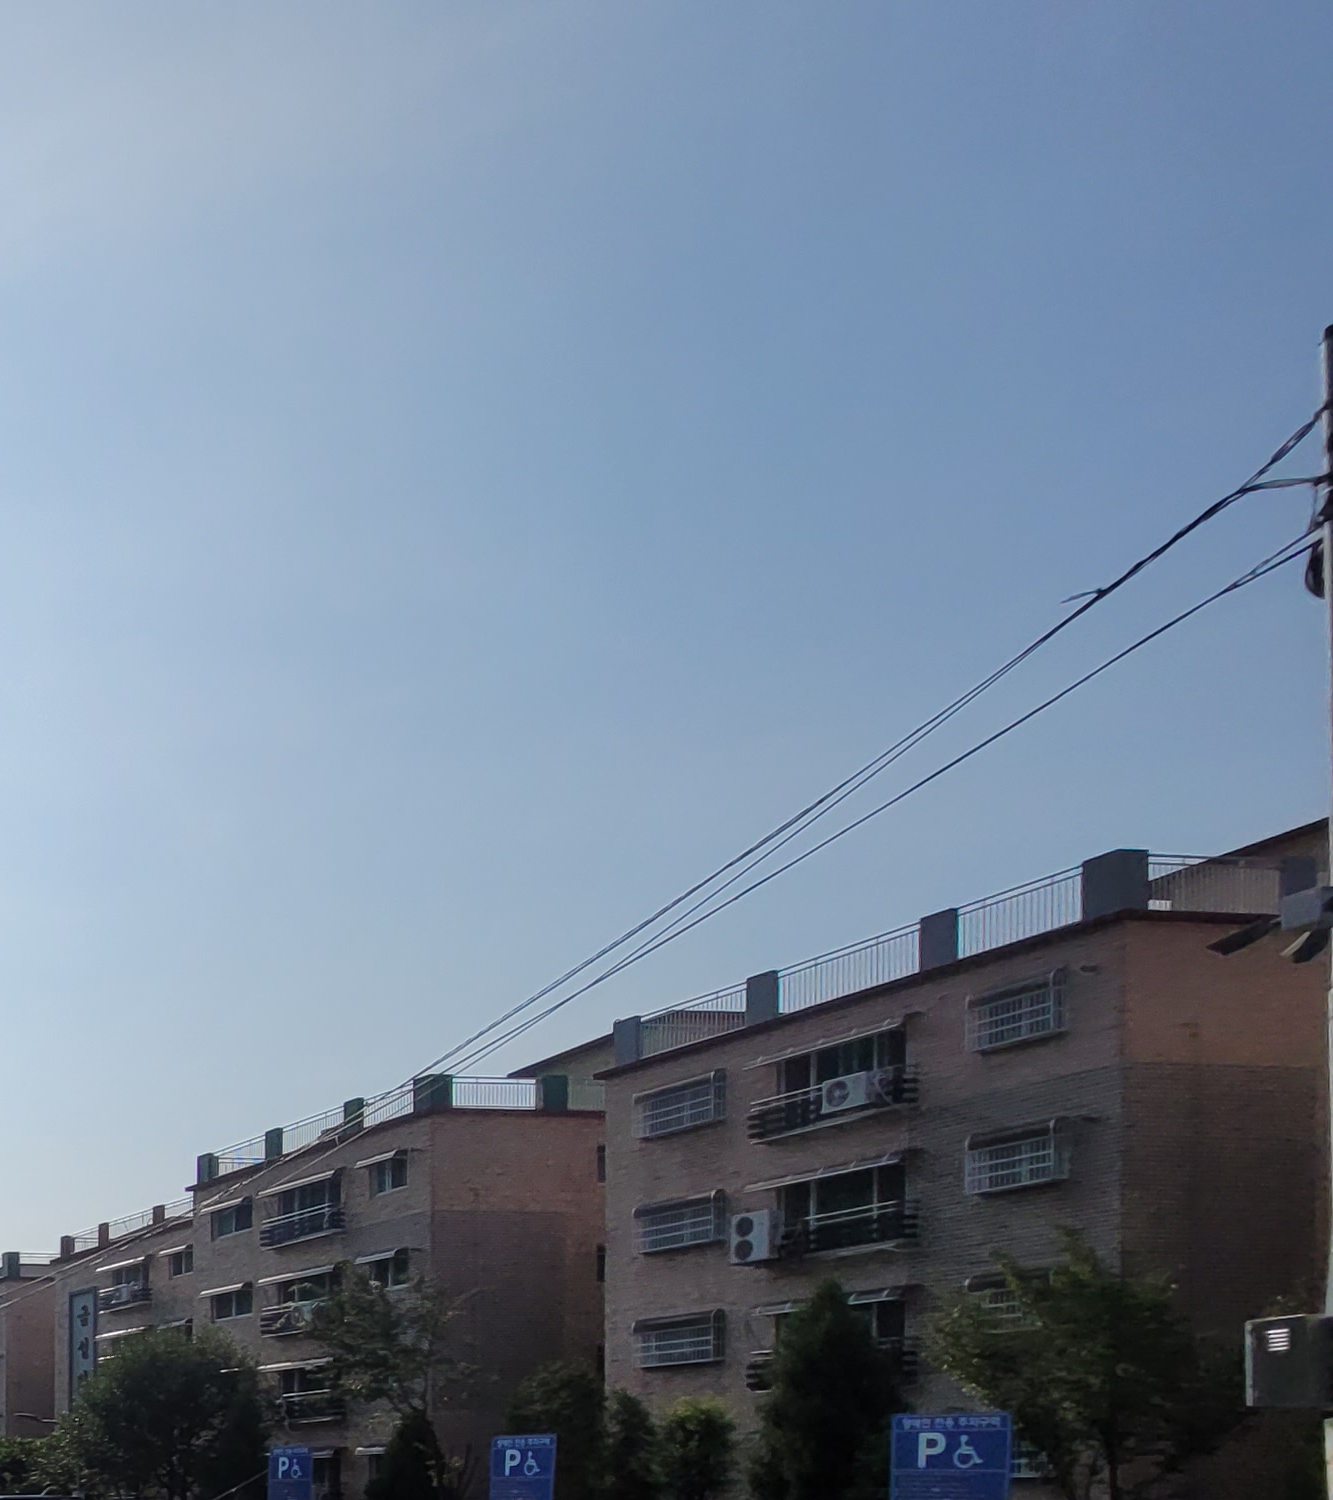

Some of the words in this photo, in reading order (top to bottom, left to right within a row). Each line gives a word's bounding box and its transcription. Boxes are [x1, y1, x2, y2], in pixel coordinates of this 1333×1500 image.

[504, 1449, 521, 1476] P
[917, 1431, 946, 1469] P
[278, 1456, 290, 1479] P
